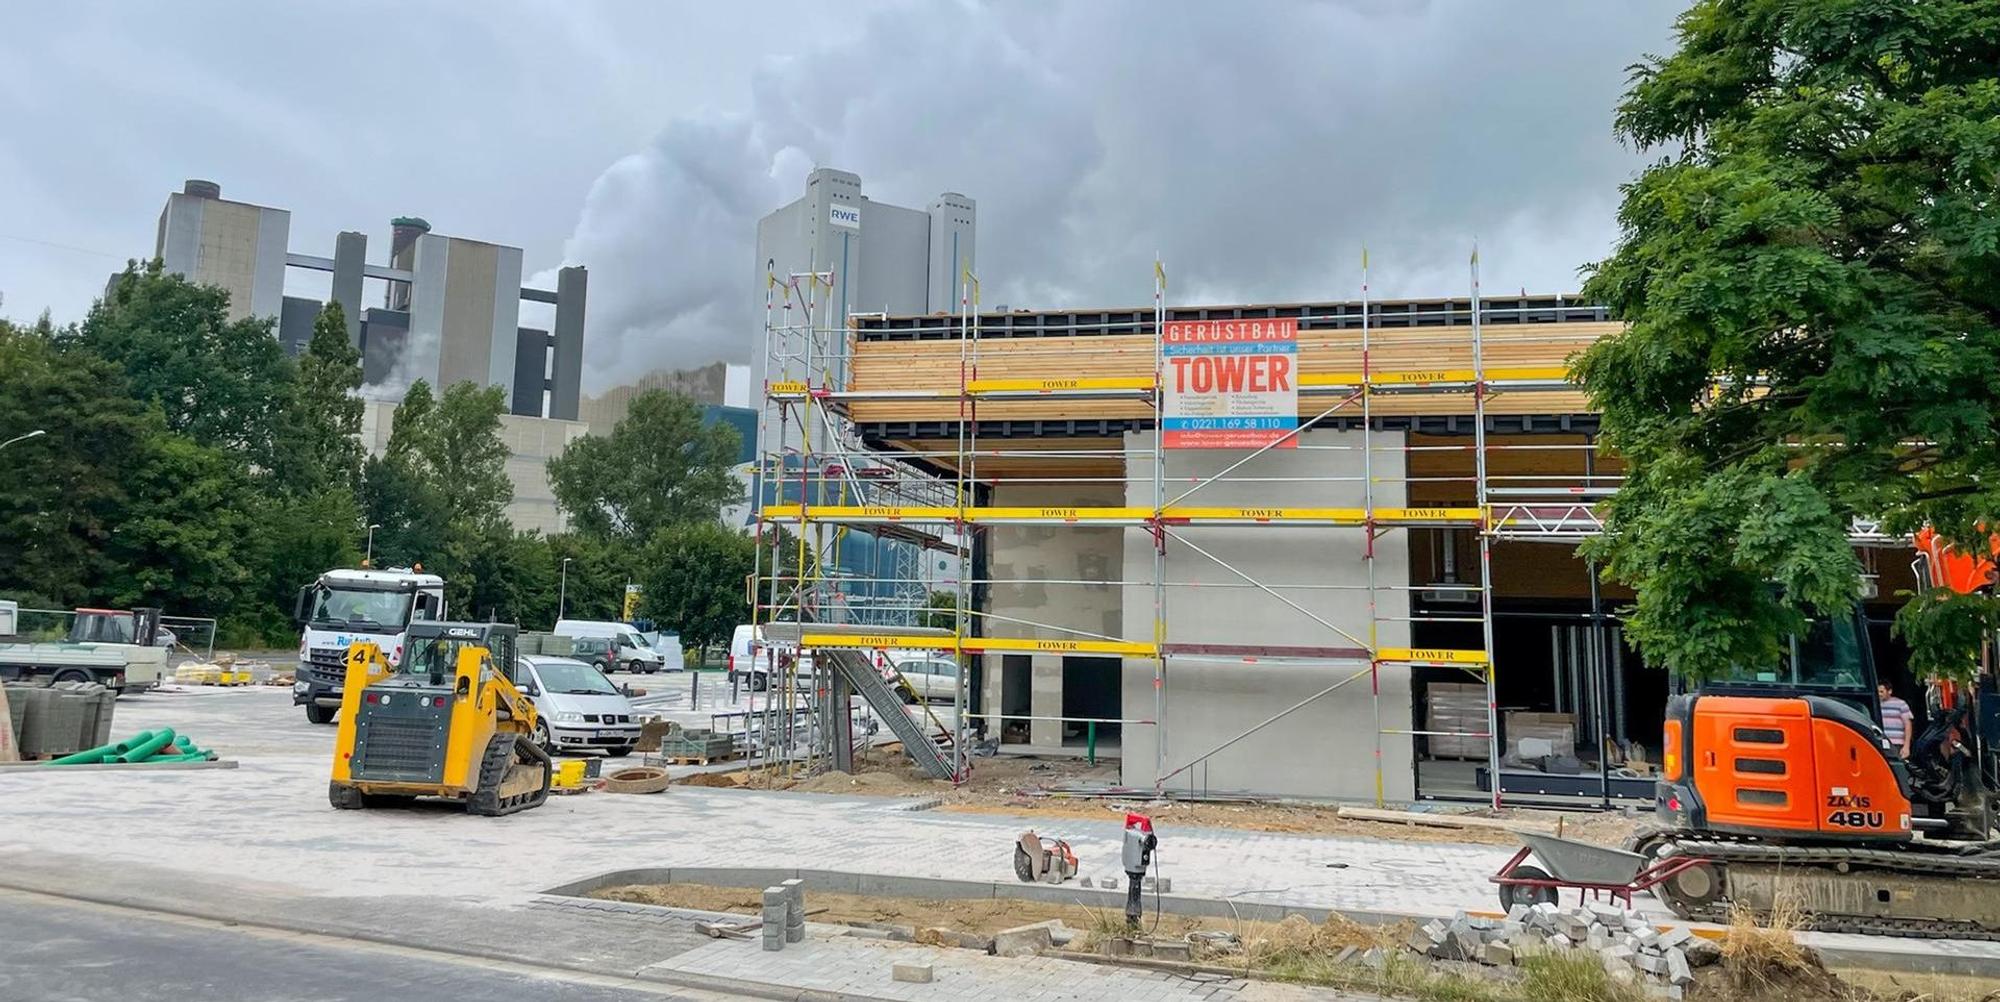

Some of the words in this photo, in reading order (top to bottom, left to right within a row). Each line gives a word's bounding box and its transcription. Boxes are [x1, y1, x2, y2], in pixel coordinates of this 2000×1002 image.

[831, 209, 858, 222] RWE
[1170, 320, 1290, 342] GERÜSTBAU
[1170, 344, 1213, 355] Sicherheit
[1230, 344, 1254, 354] unser
[1257, 343, 1290, 353] Partner
[1170, 355, 1290, 394] TOWER
[1401, 372, 1446, 382] TOWER
[1041, 380, 1077, 388] TOWER
[1244, 419, 1257, 429] 58
[1261, 418, 1280, 428] 110
[1041, 509, 1077, 517] TOWER
[1240, 509, 1283, 518] TOWER
[1402, 509, 1447, 518] TOWER
[448, 628, 477, 636] GEHL
[860, 637, 898, 646] TOWER
[1037, 641, 1077, 650] TOWER
[353, 649, 365, 664] 4
[1408, 651, 1454, 660] TOWER
[1827, 795, 1871, 808] ZAXIS
[1828, 811, 1883, 828] 48U
